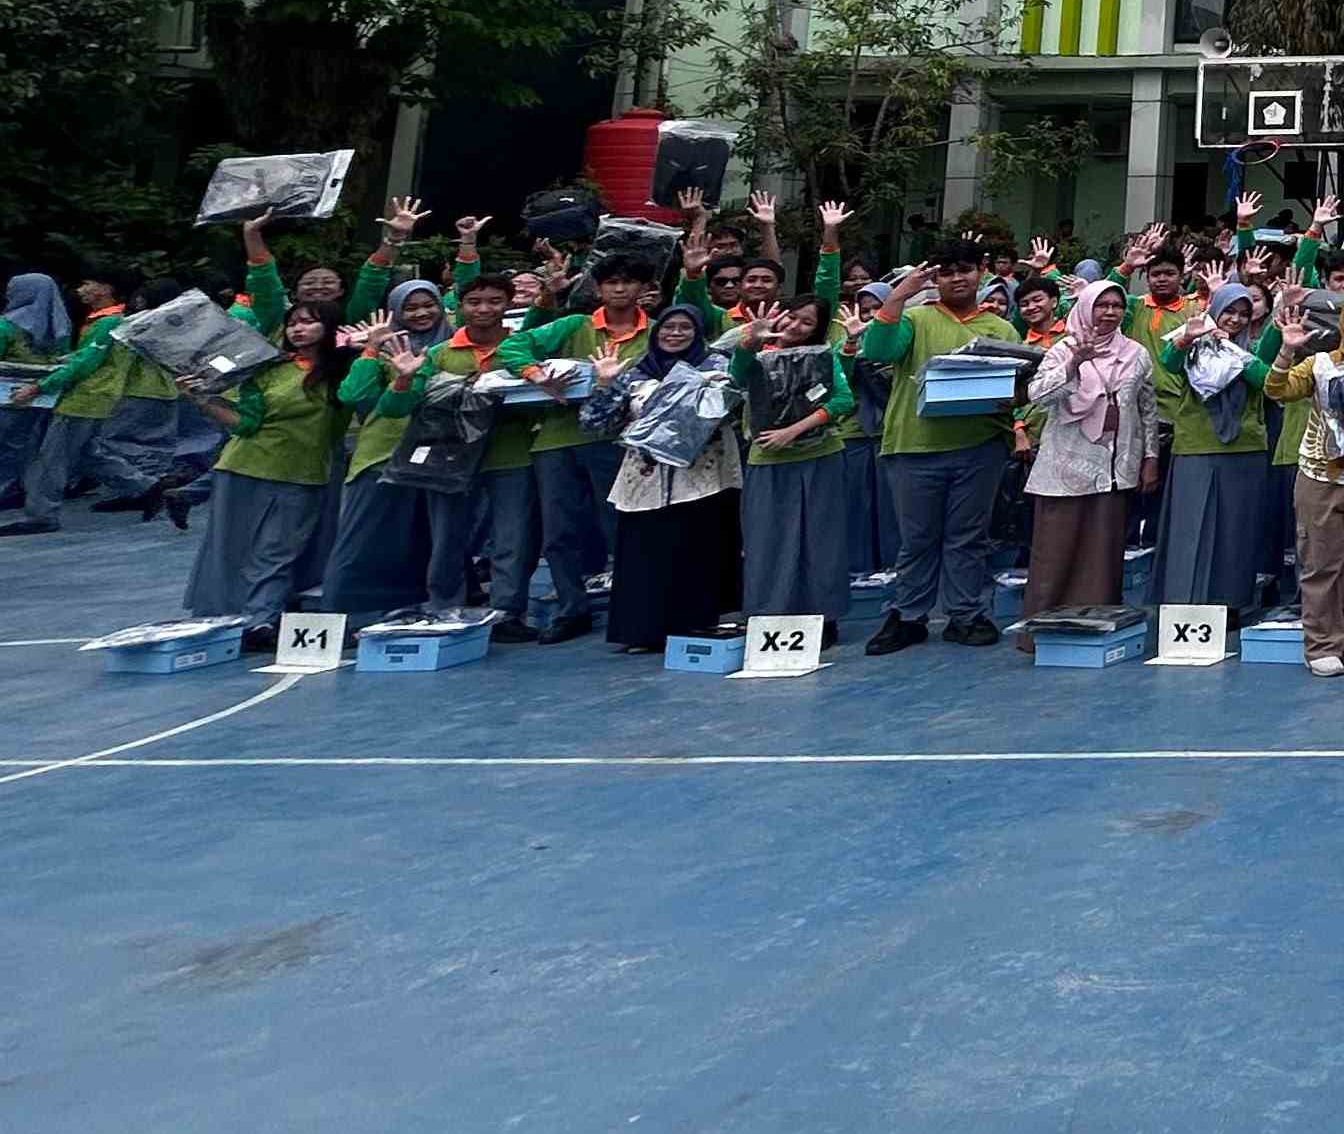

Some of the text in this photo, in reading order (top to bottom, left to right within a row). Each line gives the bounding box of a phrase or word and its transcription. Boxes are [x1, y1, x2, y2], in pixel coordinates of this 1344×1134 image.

[291, 627, 328, 650] X-1
[760, 630, 805, 652] X-2
[1172, 623, 1212, 643] X-3
